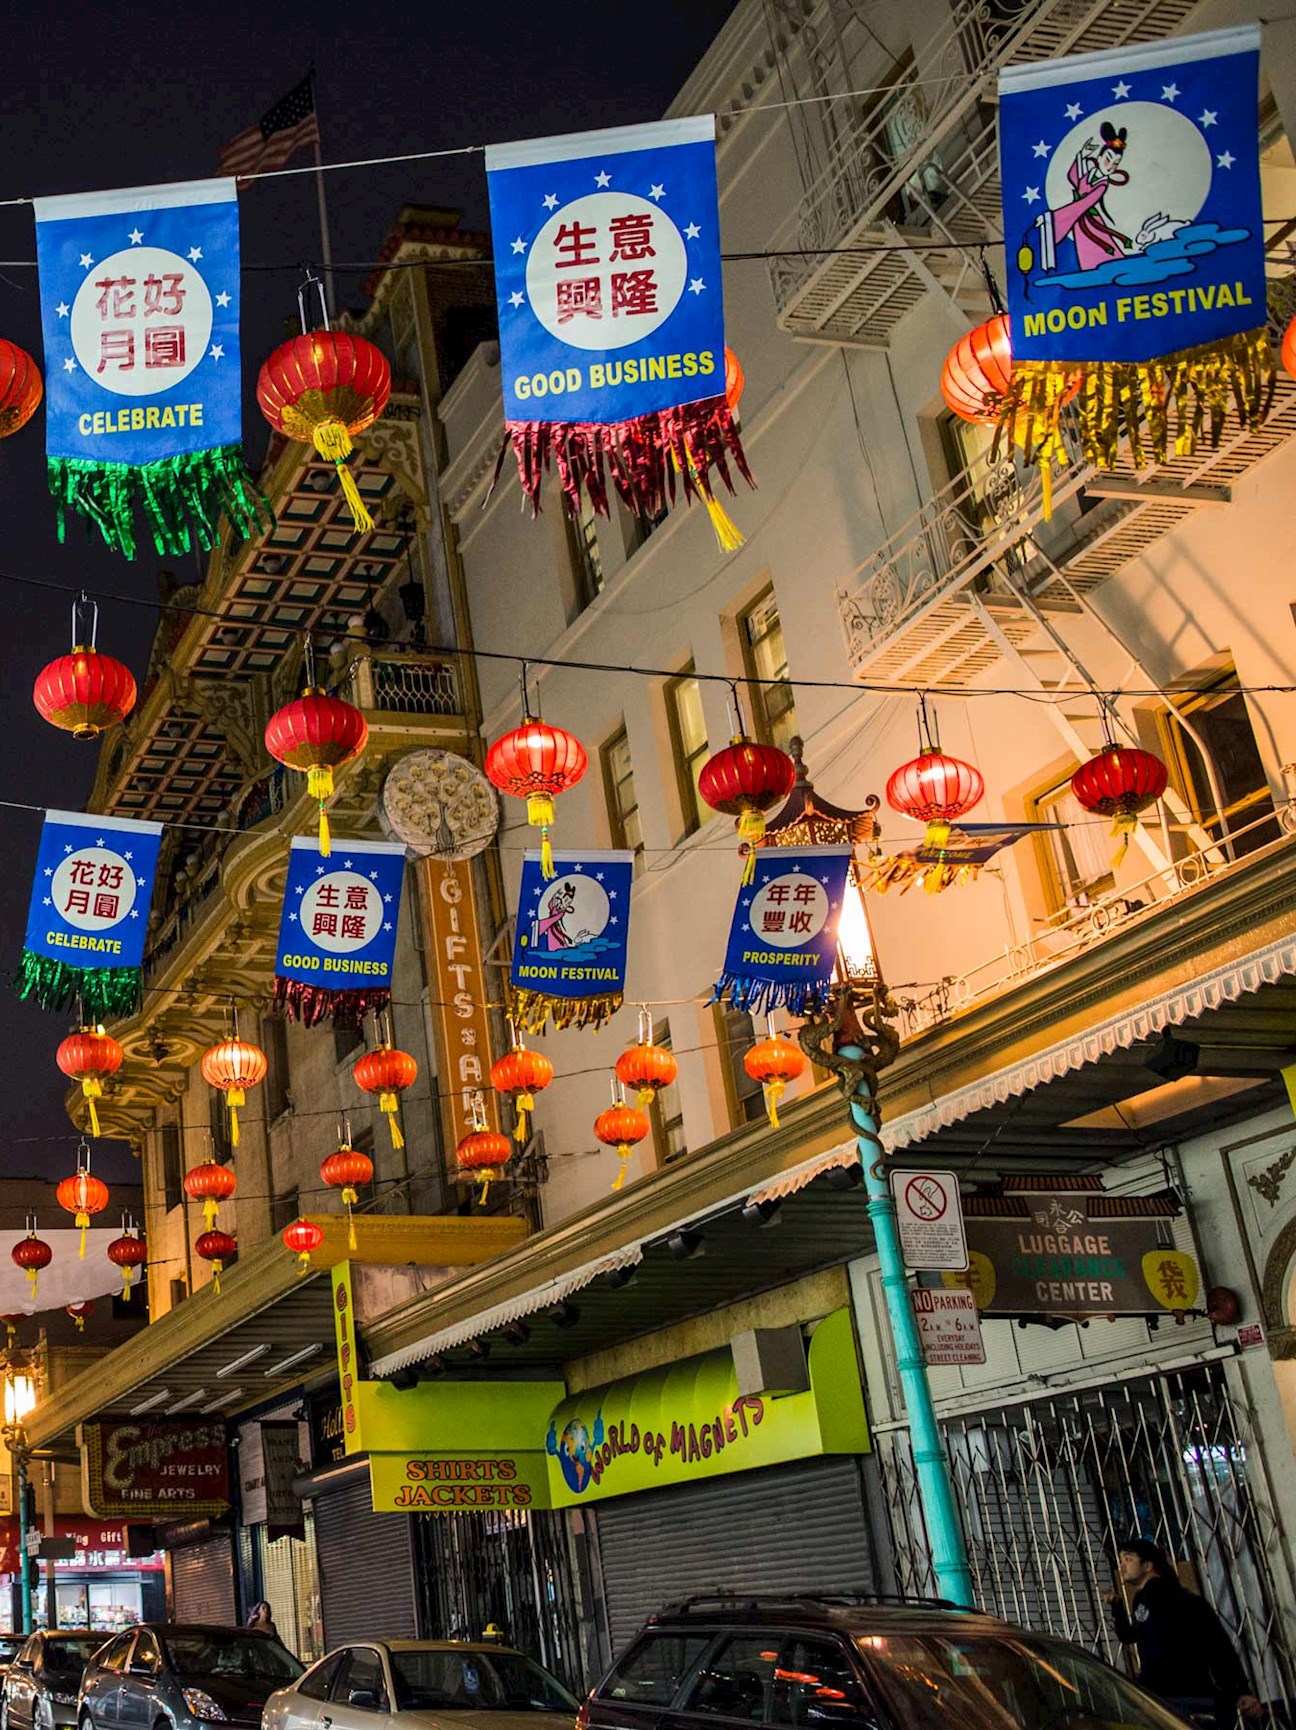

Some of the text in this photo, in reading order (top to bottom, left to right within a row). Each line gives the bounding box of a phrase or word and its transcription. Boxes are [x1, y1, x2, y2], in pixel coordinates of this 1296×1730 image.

[554, 213, 656, 269] 生意
[95, 273, 186, 321] 花好
[556, 269, 659, 325] 興隆
[1023, 281, 1253, 338] MOON FESTIVAL
[96, 325, 186, 374] 月圓
[514, 350, 715, 401] GOOD BUSINESS
[78, 403, 204, 437] CELEBRATE
[70, 860, 124, 890] 花好
[64, 889, 120, 919] 月圓
[315, 883, 369, 911] 生意
[765, 883, 818, 906] 年年
[312, 912, 366, 940] 興隆
[761, 910, 814, 934] 豐收
[46, 931, 122, 955] CELEBRATE
[283, 953, 388, 976] GOOD BUSINESS
[742, 951, 821, 966] PROSPERITY
[518, 965, 620, 980] MOON FESTIVAL
[439, 877, 475, 1019] GIFTS
[458, 1053, 487, 1127] AR
[1018, 1234, 1112, 1255] LUGGAGE
[912, 1290, 974, 1311] NO PARKING
[1035, 1280, 1116, 1302] CENTER
[926, 1343, 981, 1352] INCLUDING HOLIDAYS
[937, 1334, 965, 1343] EVERYDAY
[336, 1282, 356, 1434] GIFTS
[930, 1353, 982, 1362] STREET CLEANING
[590, 1419, 641, 1486] WORLD
[669, 1395, 764, 1464] MAGNETS
[105, 1423, 226, 1490] Empress
[160, 1464, 222, 1476] JEWELRY
[406, 1459, 517, 1481] SHIRTS
[121, 1487, 196, 1500] FINE ARTS
[394, 1484, 533, 1507] JACKETS
[100, 1531, 122, 1543] Gift
